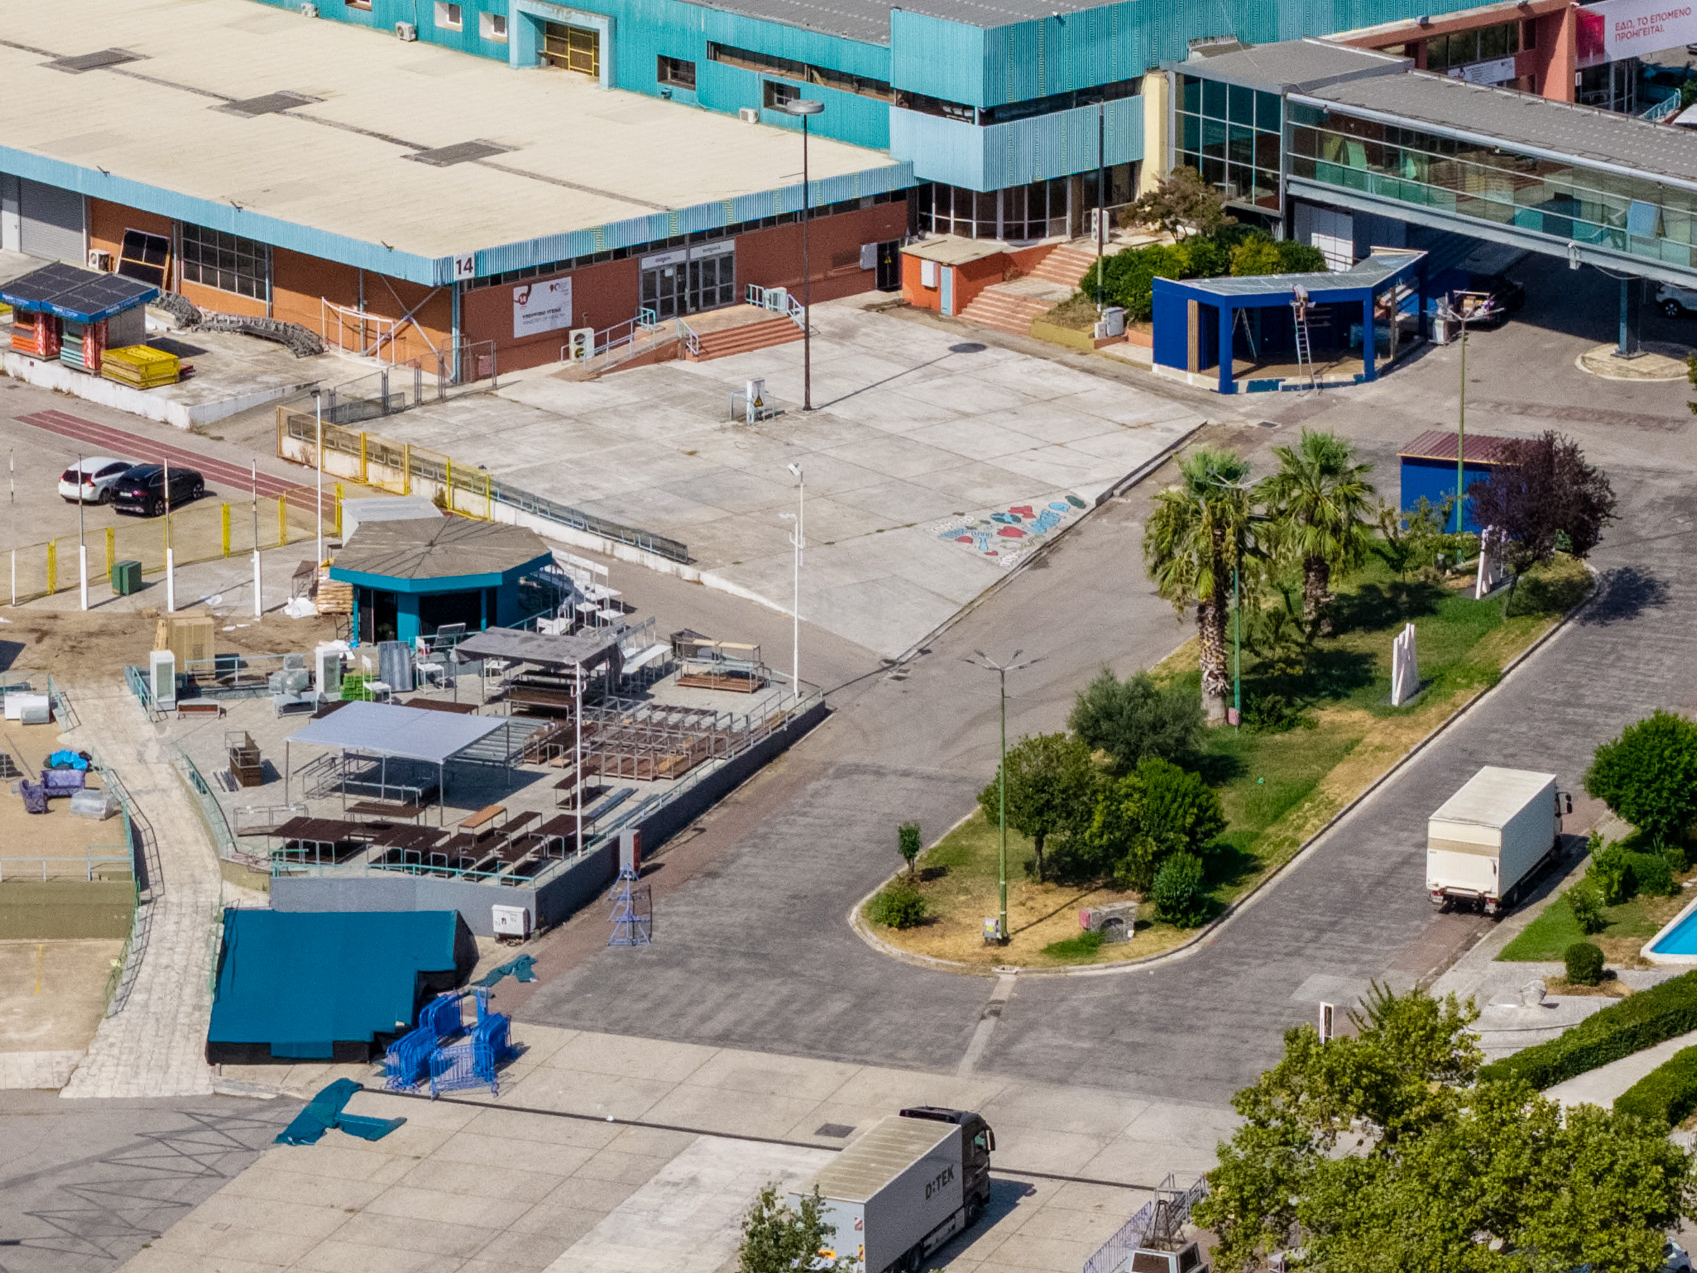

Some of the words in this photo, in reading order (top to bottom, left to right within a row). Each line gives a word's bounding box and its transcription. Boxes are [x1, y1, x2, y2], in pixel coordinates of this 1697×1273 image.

[1637, 14, 1649, 27] ΤΟ
[1650, 6, 1692, 25] ΕΠΟΜΕΝΟ
[456, 258, 474, 275] 14
